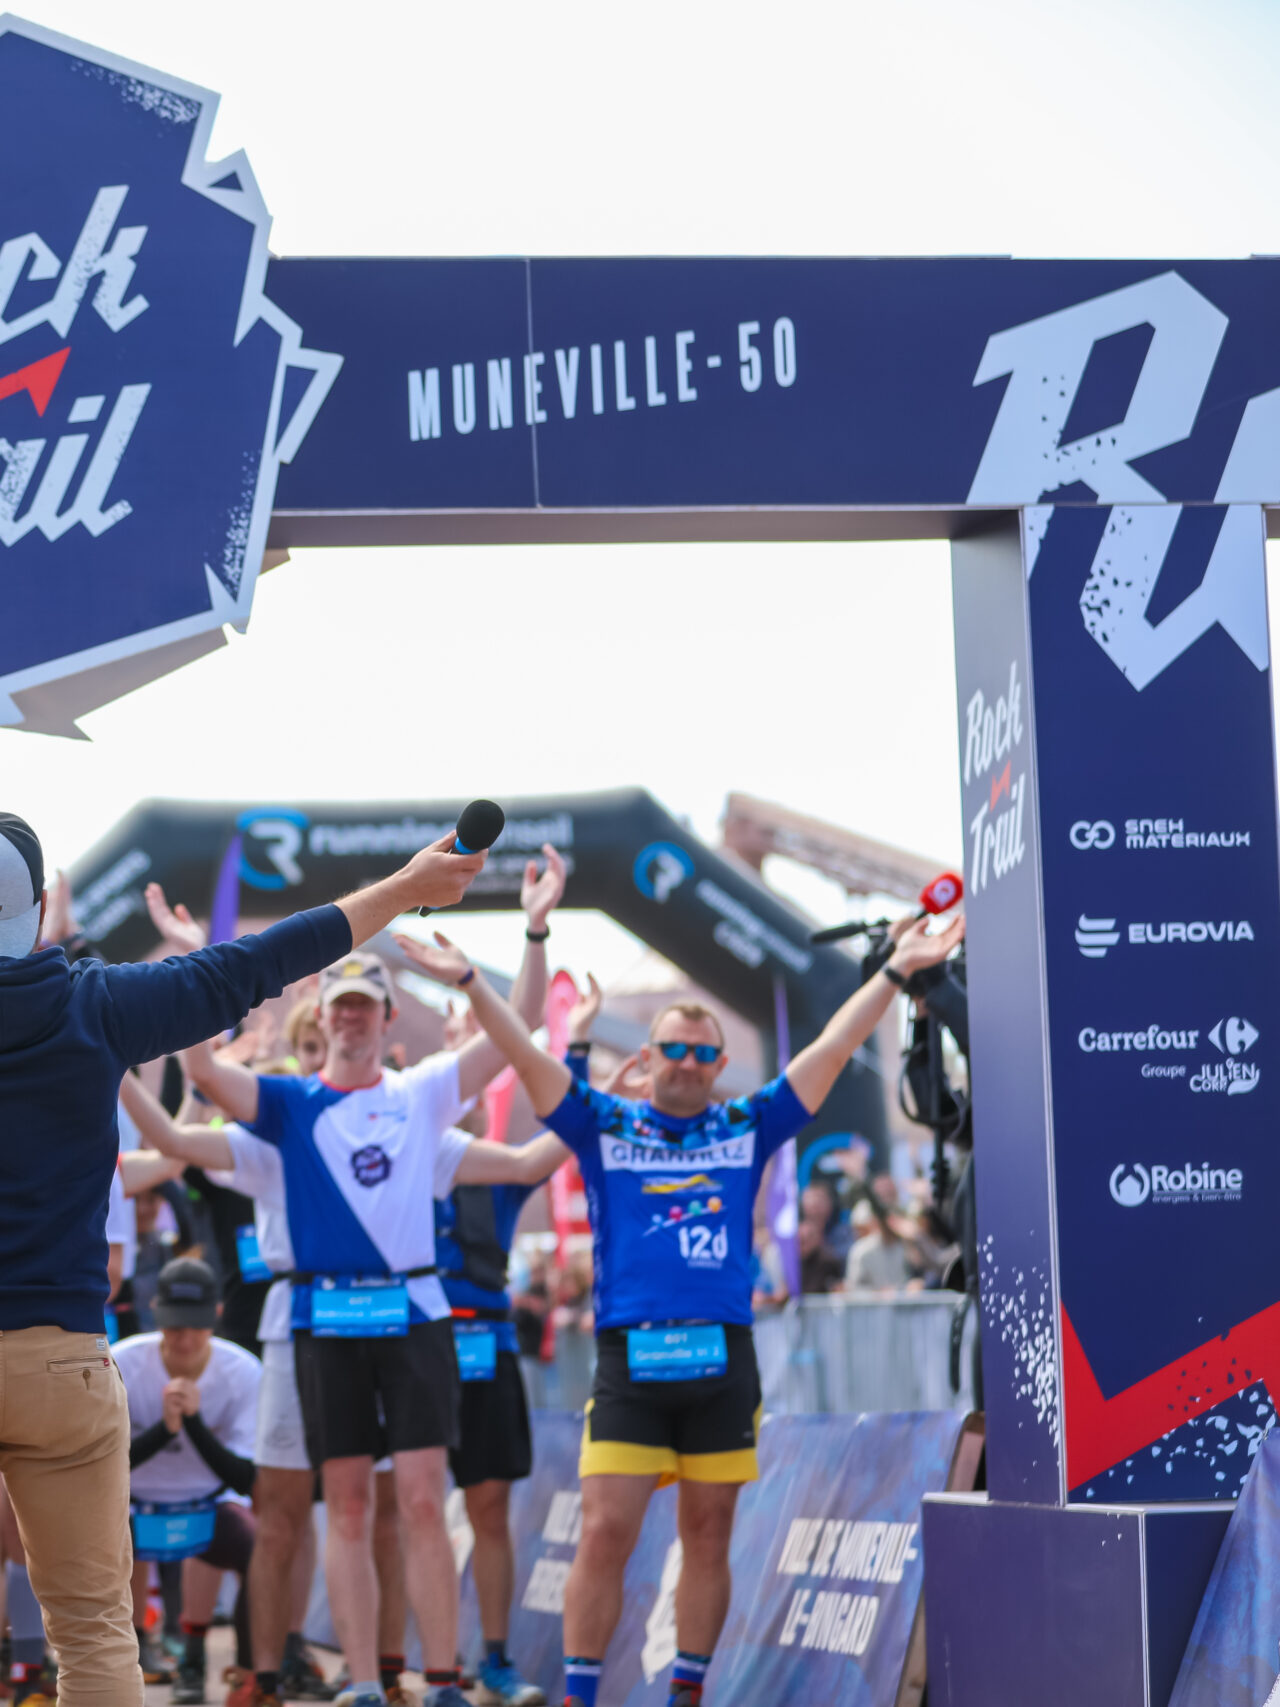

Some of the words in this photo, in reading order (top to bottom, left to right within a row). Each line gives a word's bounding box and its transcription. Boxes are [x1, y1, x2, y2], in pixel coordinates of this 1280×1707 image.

[964, 660, 1023, 786] Rock
[970, 772, 1025, 896] Trail
[1126, 832, 1250, 849] MATERIAUX
[1129, 921, 1255, 944] EUROVIA
[1078, 1024, 1200, 1053] Carrefour
[1141, 1063, 1187, 1079] Groupe
[1151, 1162, 1243, 1191] Robine
